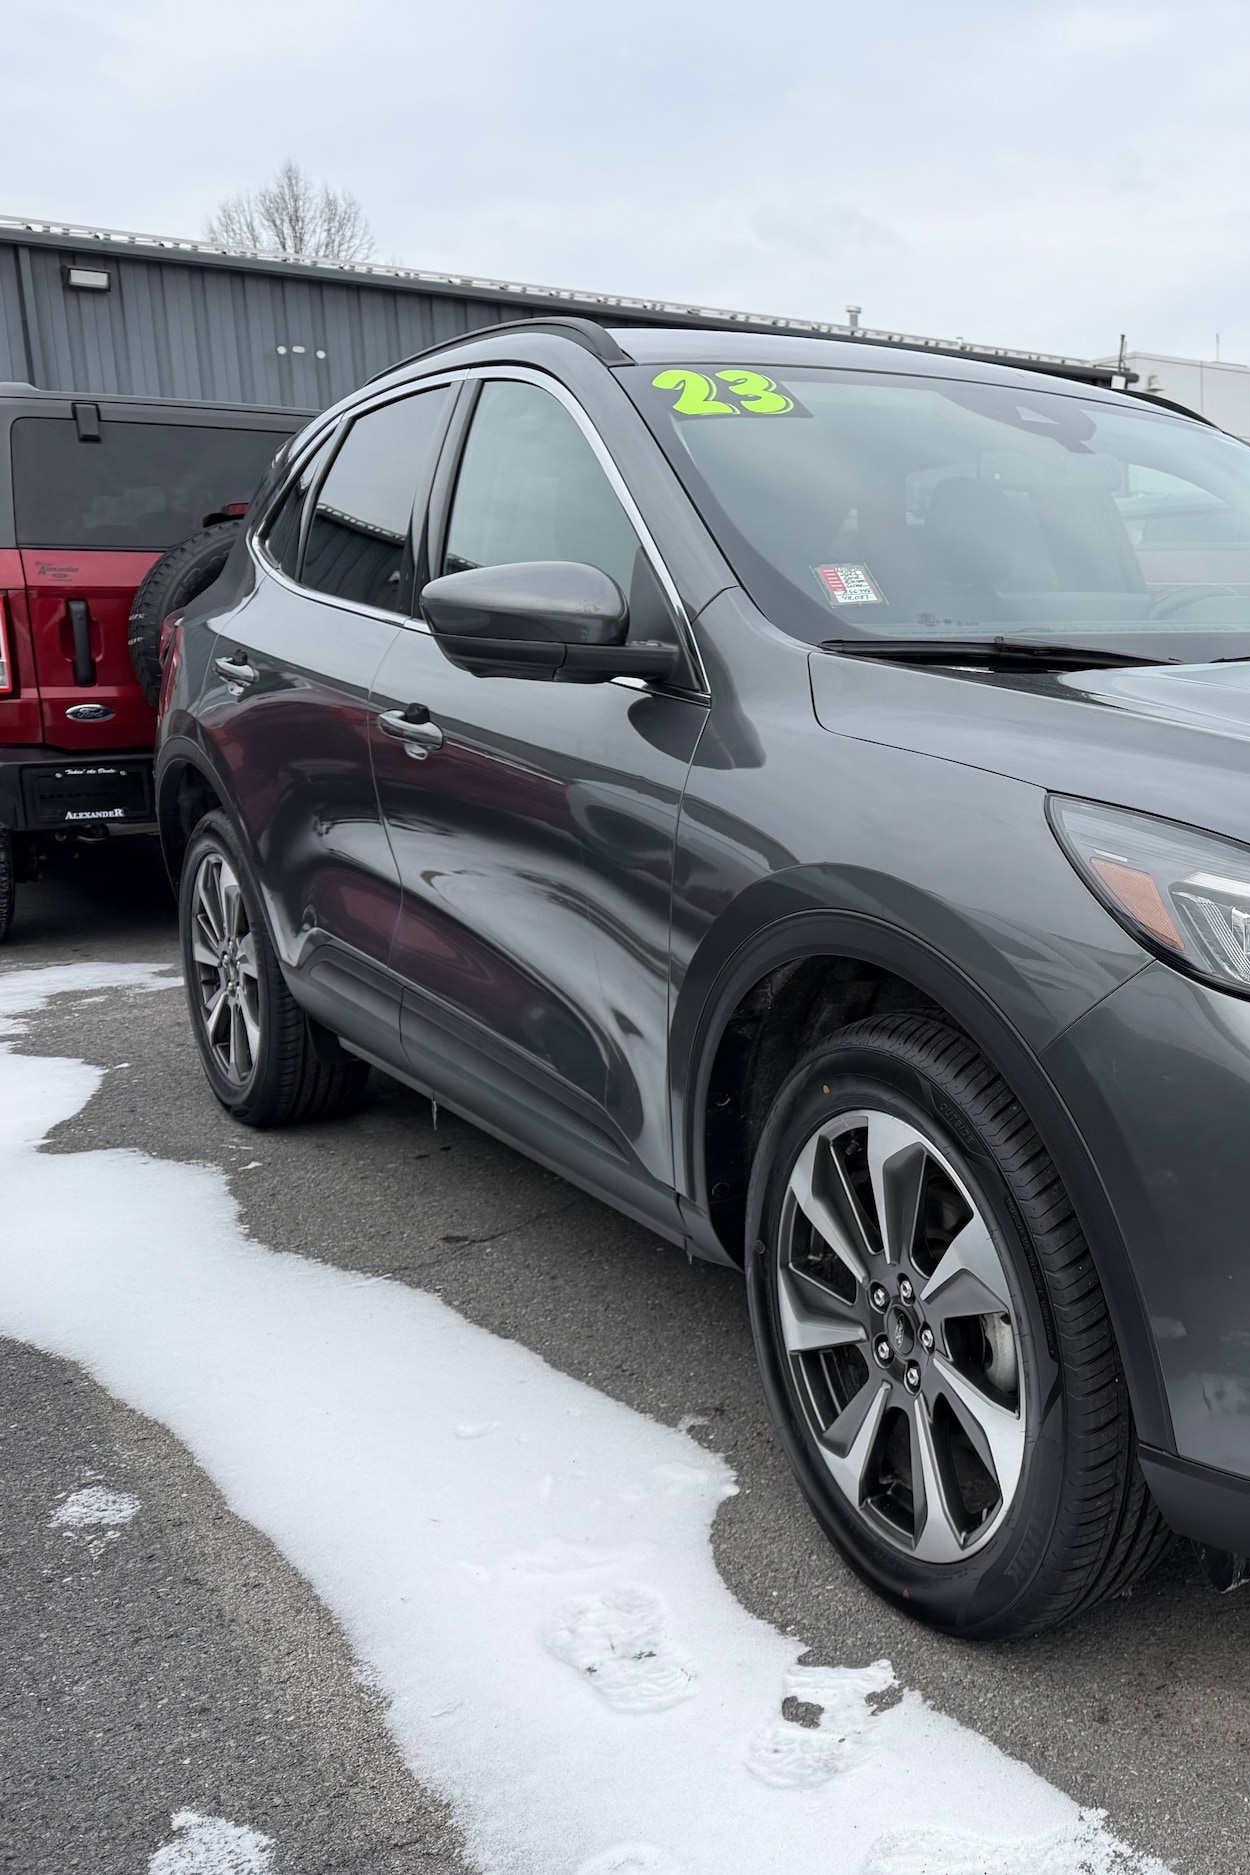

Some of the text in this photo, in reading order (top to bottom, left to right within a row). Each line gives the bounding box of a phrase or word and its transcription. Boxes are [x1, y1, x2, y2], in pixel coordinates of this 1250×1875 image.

[651, 368, 795, 416] 23
[76, 707, 104, 719] Ford
[65, 808, 126, 820] ALEXANDER
